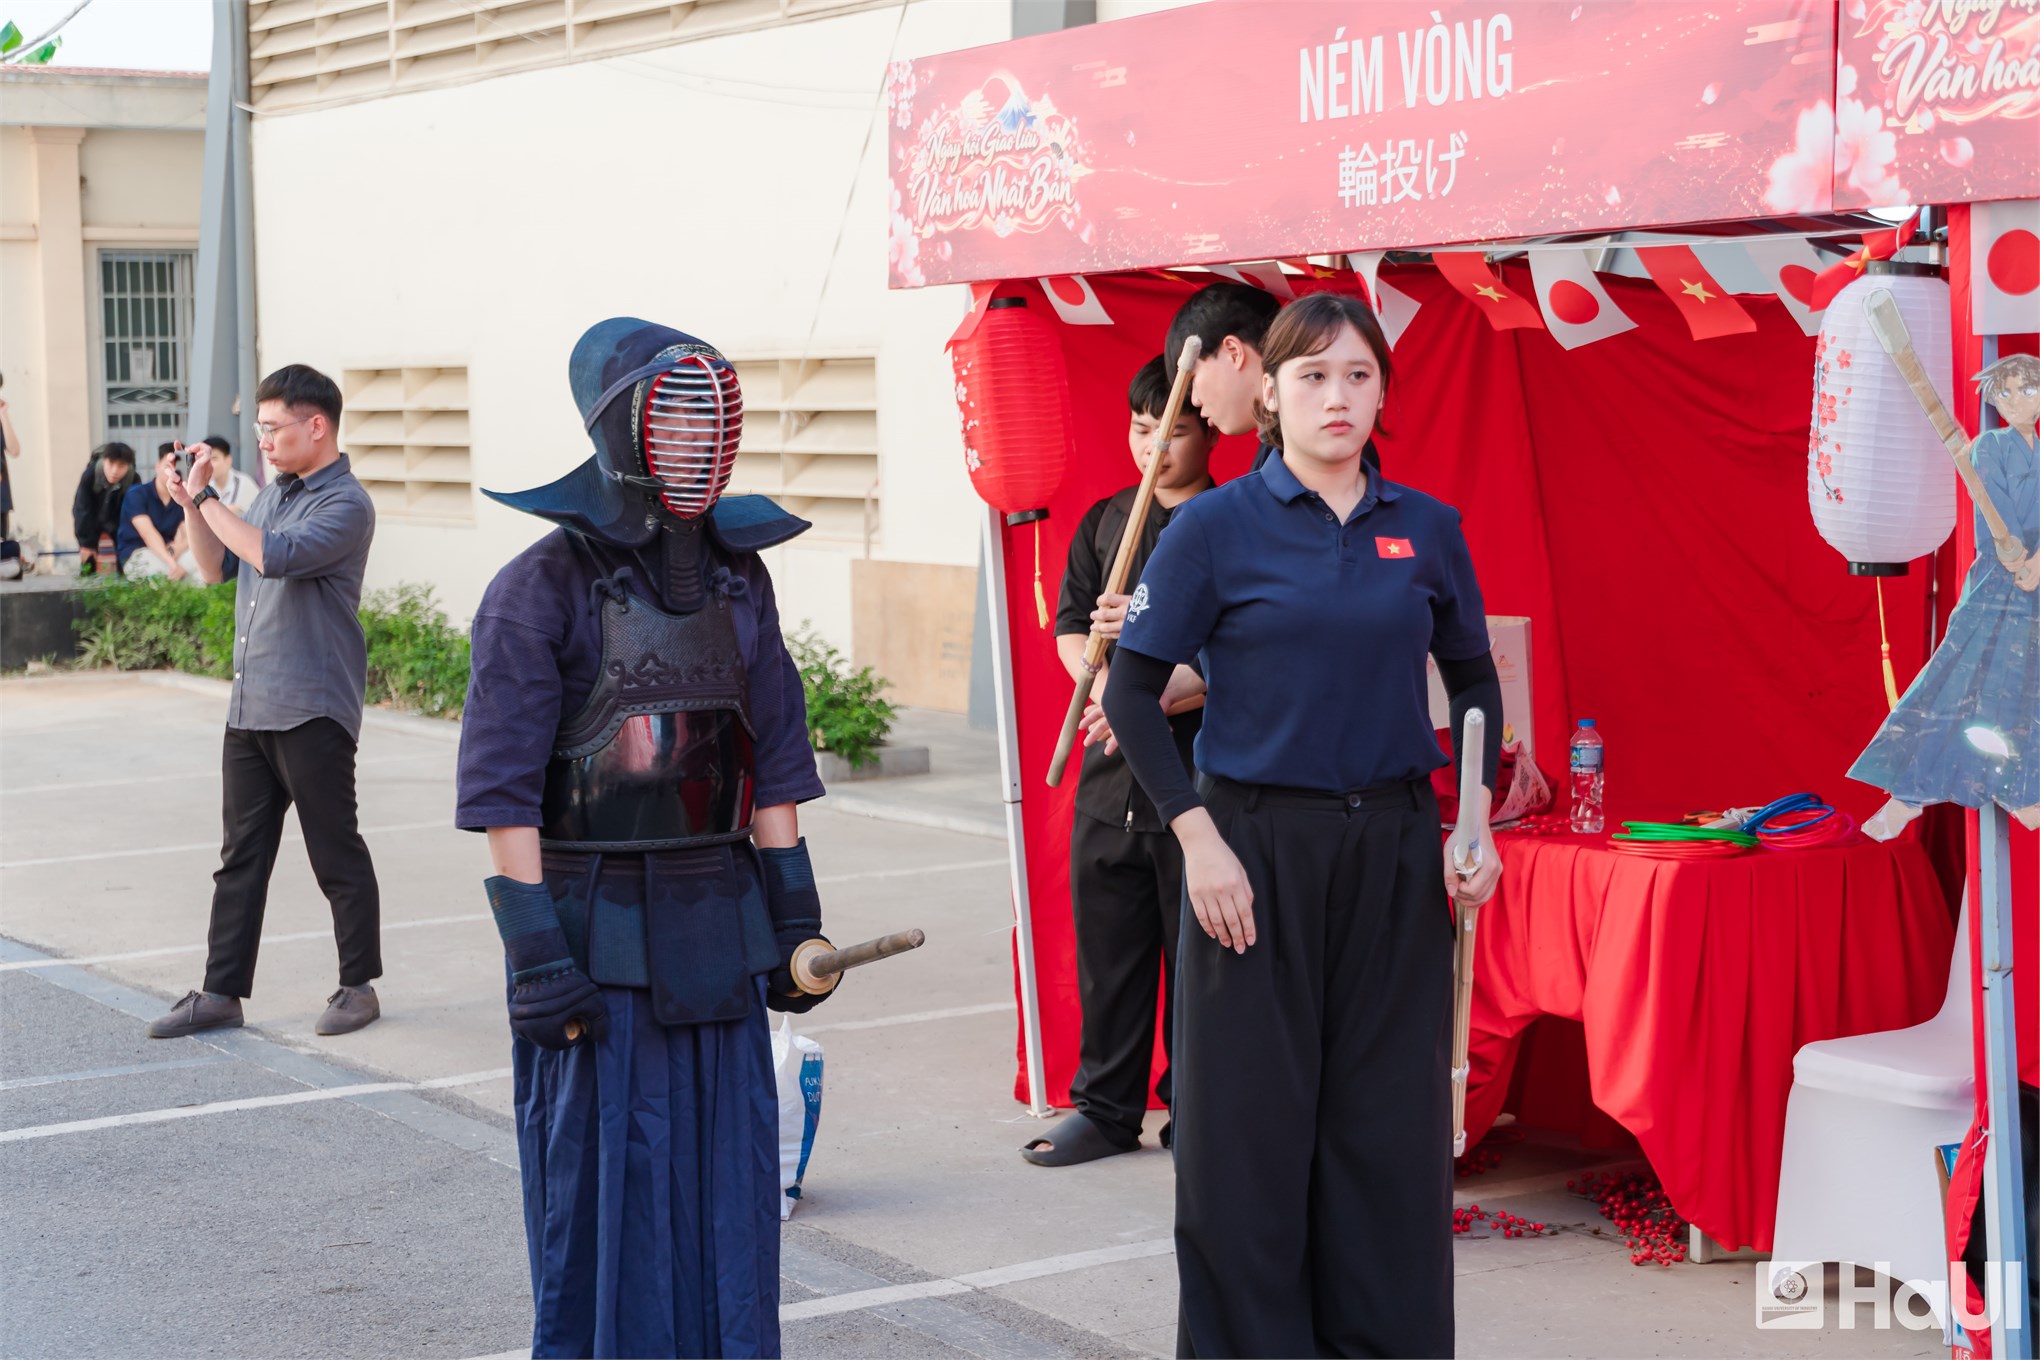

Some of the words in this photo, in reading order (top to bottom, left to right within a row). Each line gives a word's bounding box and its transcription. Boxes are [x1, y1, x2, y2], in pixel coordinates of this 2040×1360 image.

[1299, 26, 1384, 123] NÉM
[1397, 10, 1513, 109] VÒNG
[1881, 32, 1980, 118] Văn
[981, 122, 1013, 168] Giao
[1337, 130, 1469, 209] 輪投げ
[911, 170, 954, 227] Văn
[953, 175, 980, 212] hoá
[980, 166, 1028, 218] Nhật
[1025, 156, 1076, 219] Bản
